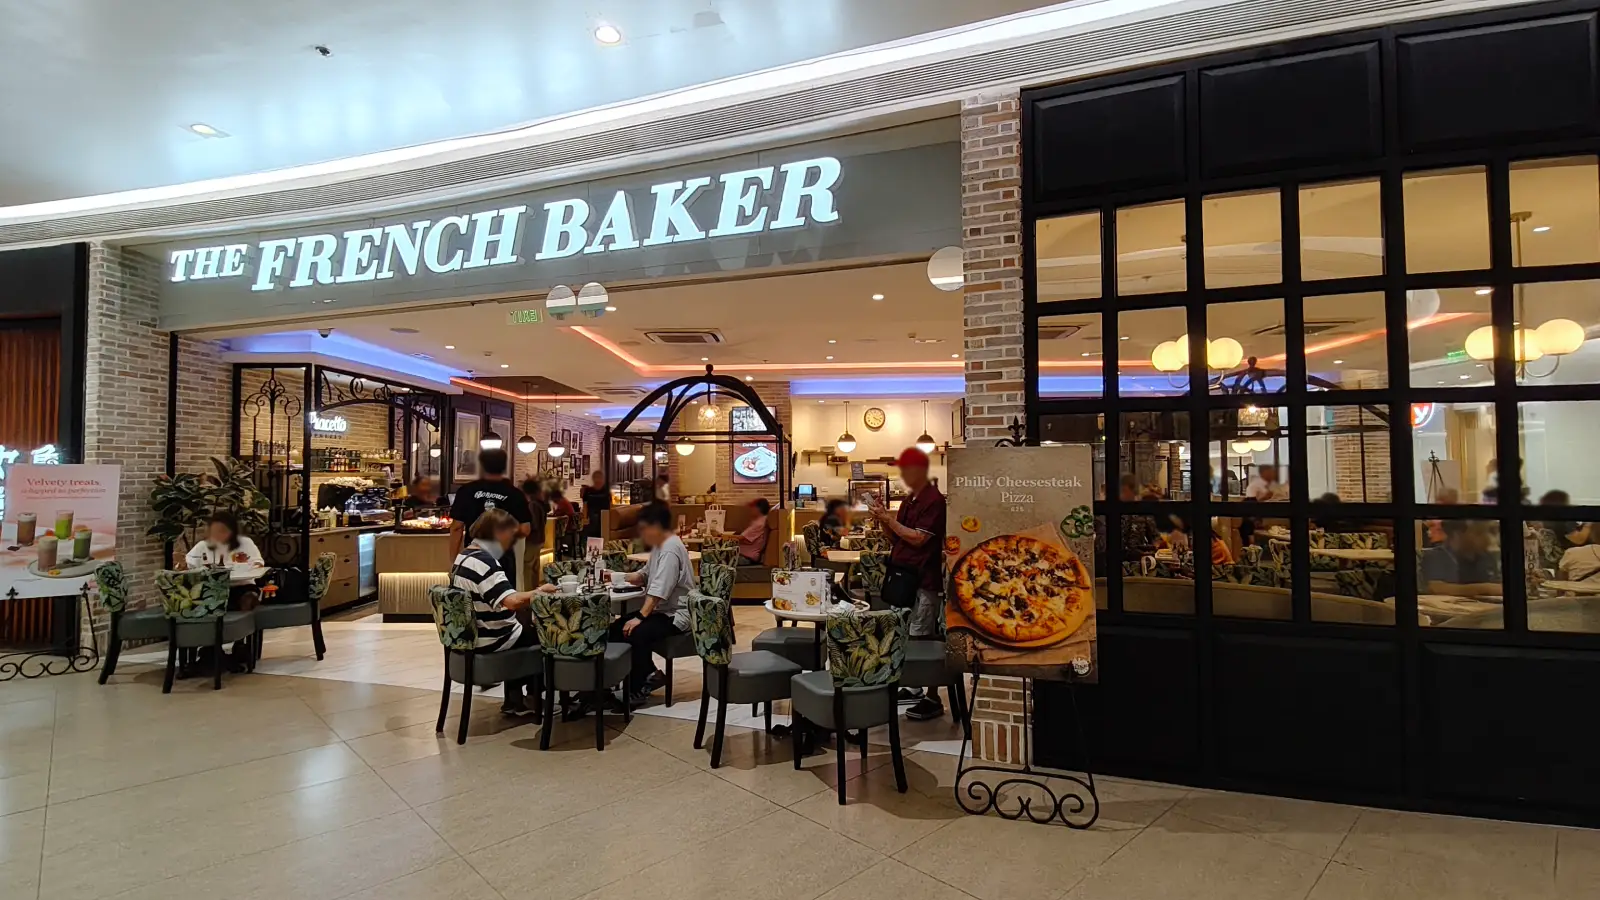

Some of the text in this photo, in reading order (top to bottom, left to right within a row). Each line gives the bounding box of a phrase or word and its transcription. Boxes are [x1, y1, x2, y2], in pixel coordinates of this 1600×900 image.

[170, 156, 841, 291] THE FRENCH BAKER
[27, 479, 67, 487] Velvety
[955, 475, 1083, 489] Philly Cheesesteak
[1001, 491, 1035, 503] Pizza
